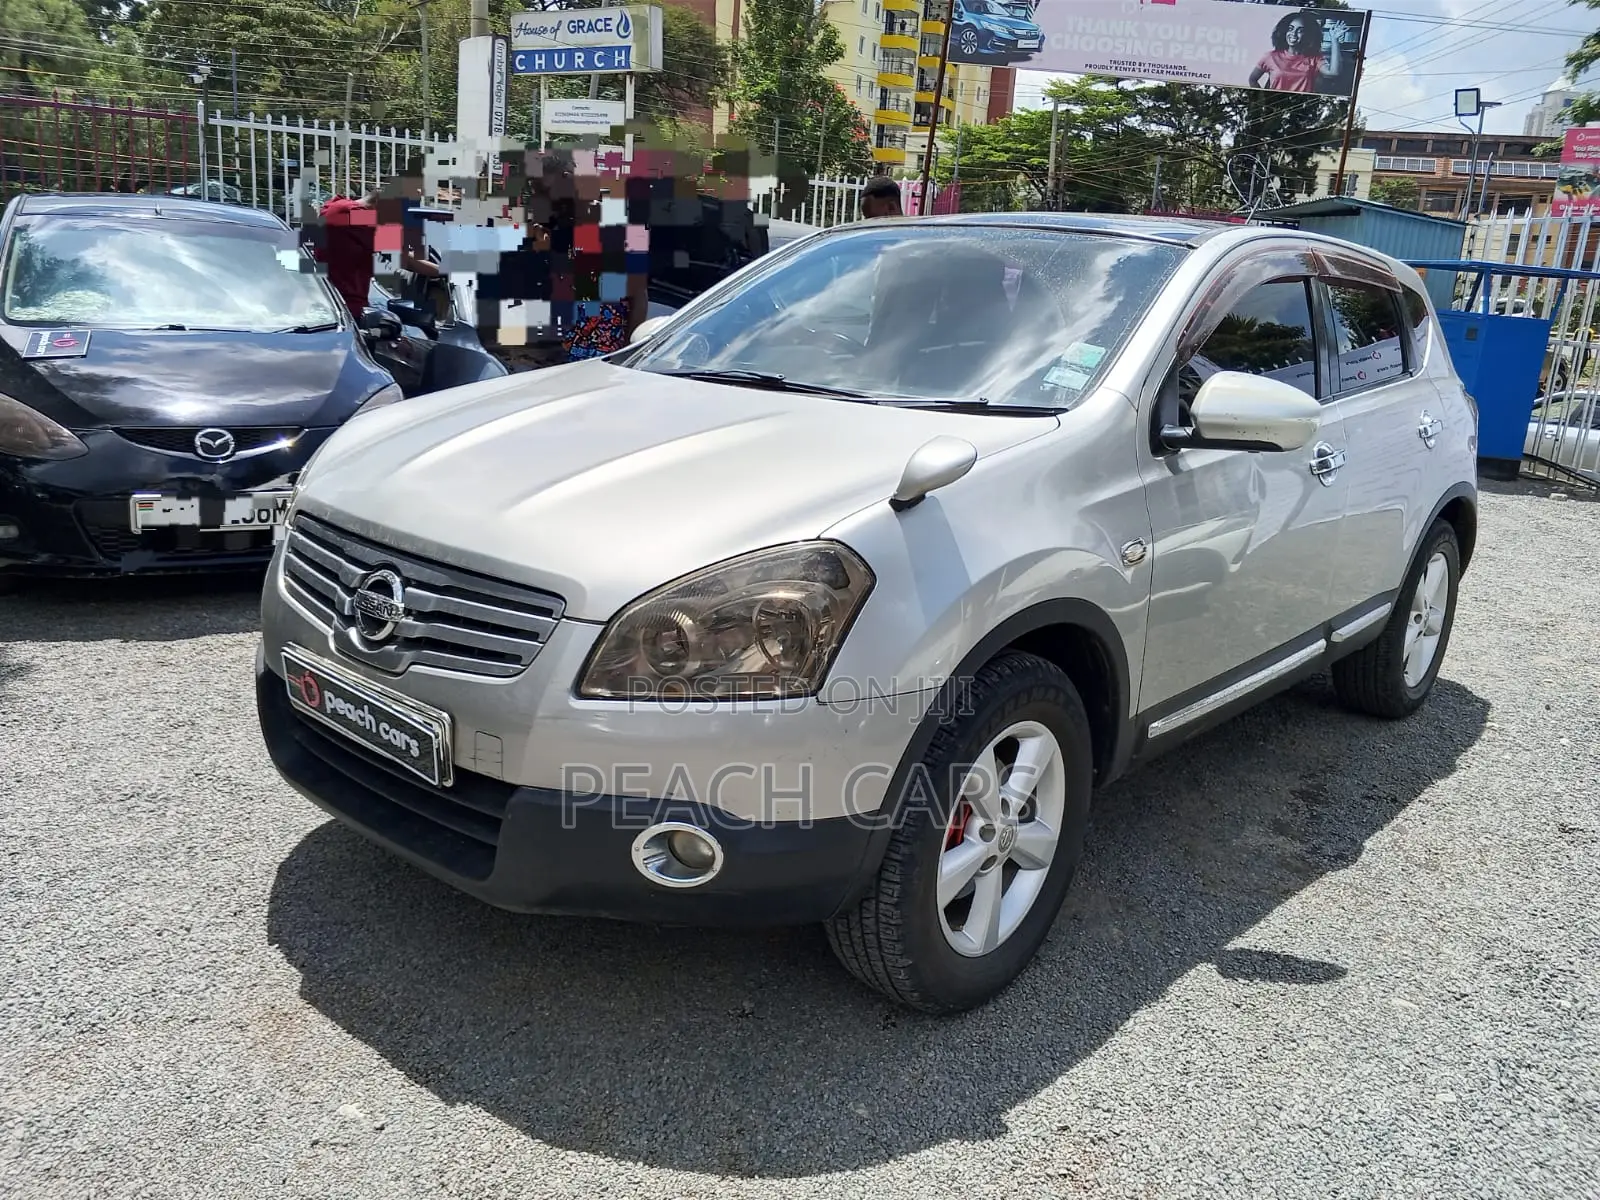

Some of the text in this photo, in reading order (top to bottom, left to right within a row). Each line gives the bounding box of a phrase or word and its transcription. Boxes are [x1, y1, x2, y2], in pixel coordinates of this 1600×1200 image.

[514, 17, 613, 41] House of GRACE
[1066, 15, 1239, 46] THANK YOU FOR
[515, 50, 625, 71] CHURCH
[1051, 32, 1249, 66] CHOOSING PEACH!
[1084, 63, 1113, 71] PROUDLY
[1114, 65, 1142, 73] KENYA'S
[1165, 70, 1212, 79] MARKETPLACE
[1109, 59, 1137, 67] TRUSTED
[323, 690, 420, 758] peach cars
